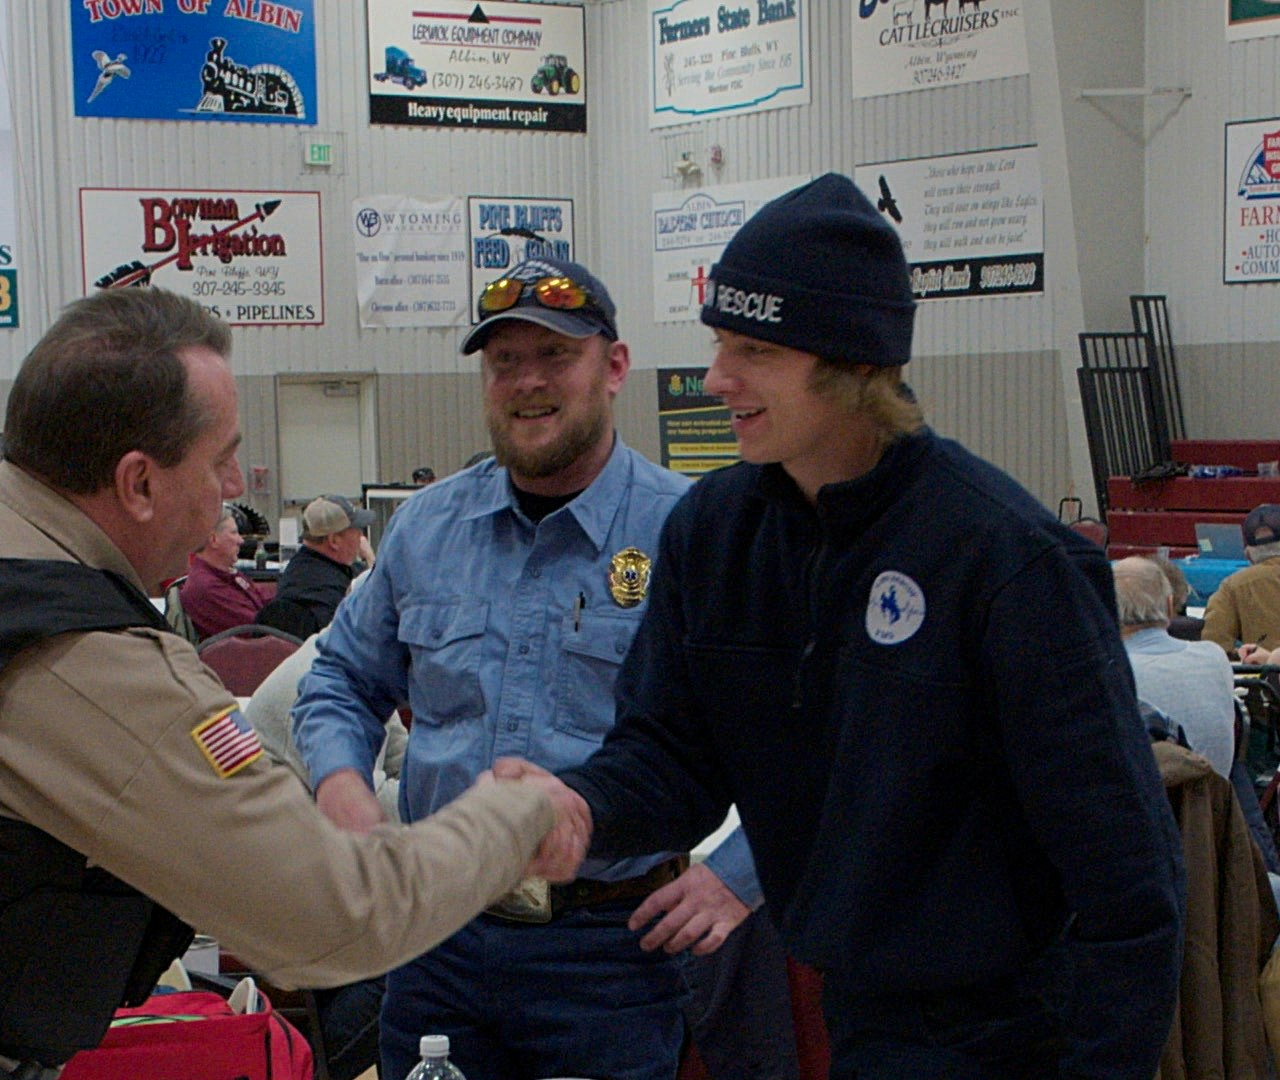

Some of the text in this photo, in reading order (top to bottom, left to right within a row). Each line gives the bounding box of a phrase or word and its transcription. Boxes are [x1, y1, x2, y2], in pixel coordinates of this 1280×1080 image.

[84, 0, 164, 23] TOWN
[224, 0, 303, 34] ALBIN
[658, 16, 711, 46] Farmers
[717, 5, 751, 33] State
[879, 9, 1000, 47] CATTLECRUISERS
[451, 27, 500, 44] EQUIPMENT
[501, 29, 543, 47] COMPANY
[492, 52, 512, 64] WY
[432, 72, 524, 90] (307) 246-3487
[408, 102, 549, 125] Heavy equipment repair
[139, 197, 240, 252] Bowman
[383, 213, 462, 225] WYOMING
[478, 204, 563, 233] PINE BLUFFS
[174, 219, 288, 272] Irrigation
[474, 237, 511, 269] FEED
[1246, 243, 1280, 260] AUTO
[237, 304, 316, 321] PIPELINES
[716, 284, 784, 323] RESCUE
